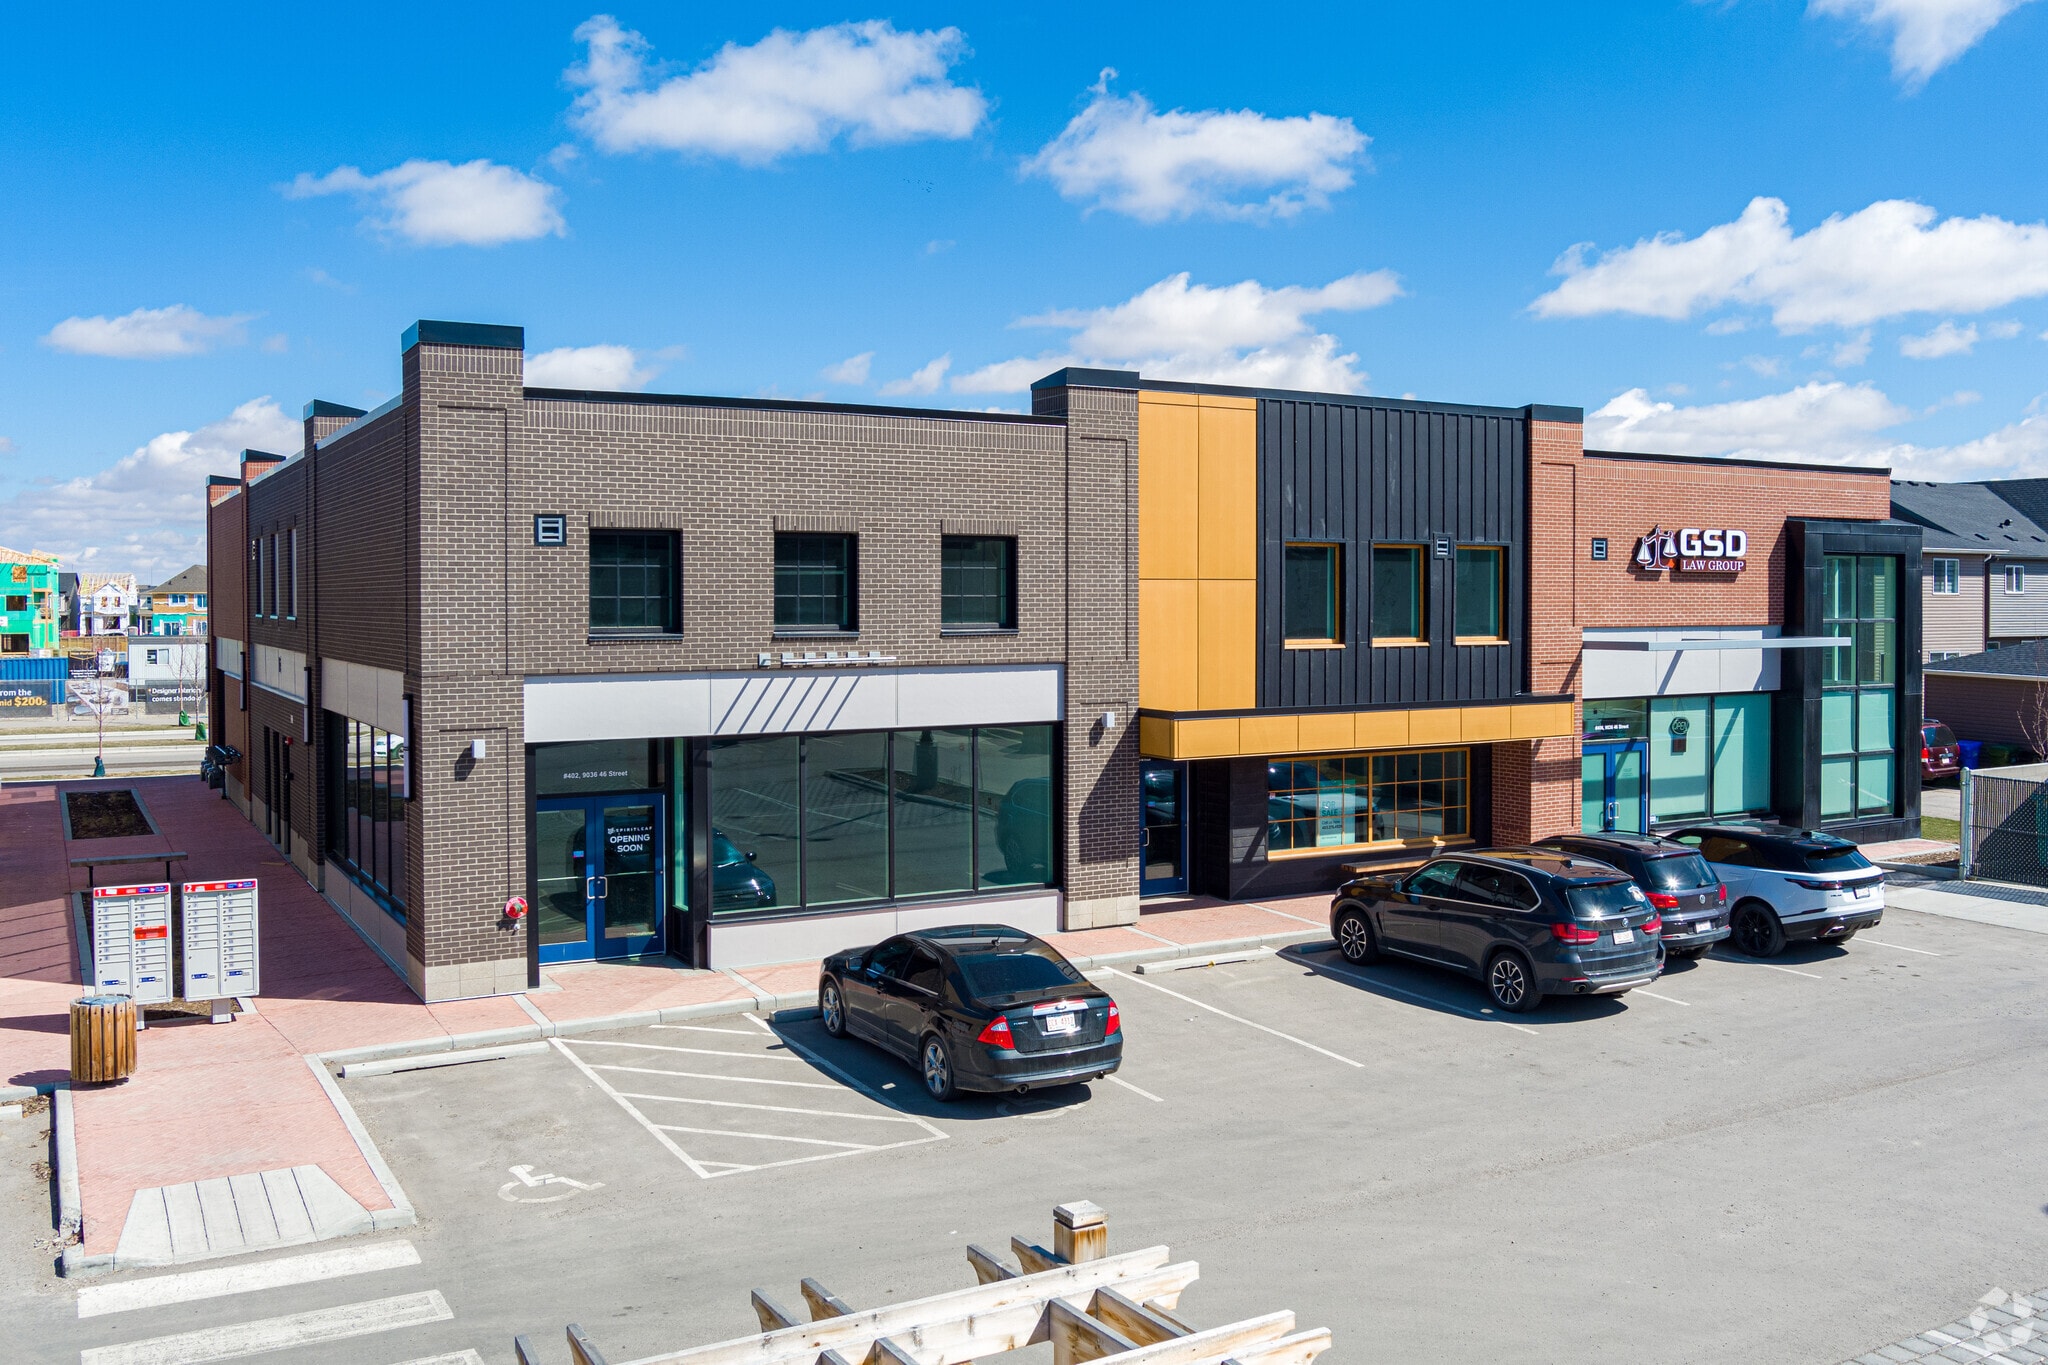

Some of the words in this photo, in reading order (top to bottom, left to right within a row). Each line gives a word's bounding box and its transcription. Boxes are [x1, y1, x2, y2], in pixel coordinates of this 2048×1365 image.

[1680, 528, 1747, 557] GSD
[1682, 560, 1706, 570] LAW
[1708, 560, 1744, 571] GROUP
[18, 688, 32, 697] the
[14, 696, 47, 708] $200s
[1321, 809, 1338, 817] SALE
[610, 834, 651, 844] OPENING
[617, 843, 643, 853] SOON
[97, 889, 102, 897] 1
